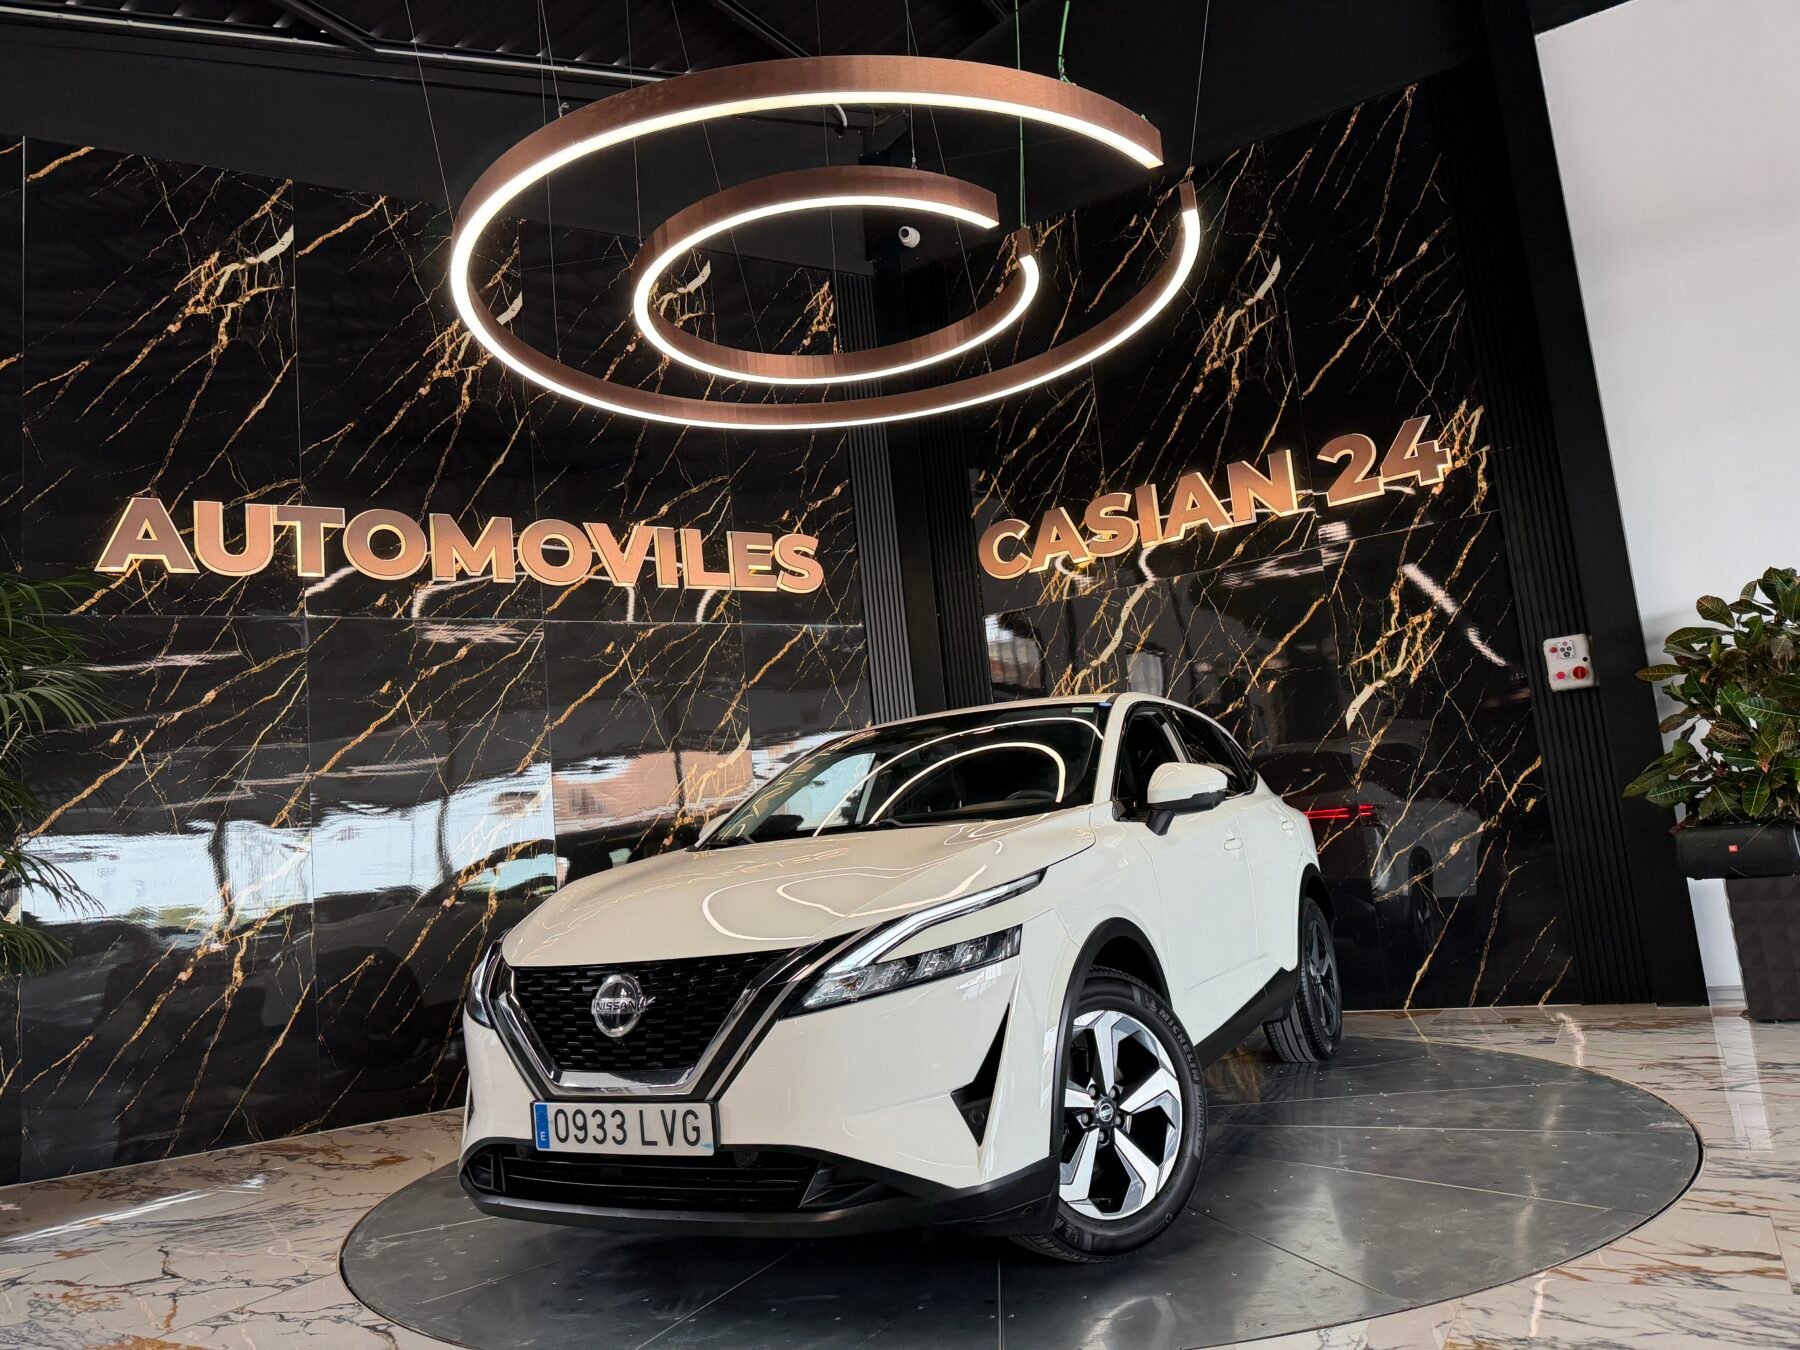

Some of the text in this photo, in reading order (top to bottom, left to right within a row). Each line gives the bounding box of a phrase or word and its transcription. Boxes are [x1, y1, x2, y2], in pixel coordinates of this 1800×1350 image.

[978, 414, 1452, 580] CASIAN 24
[94, 496, 824, 593] AUTOMOVILES
[595, 1000, 637, 1011] NISSAN
[1158, 1008, 1200, 1081] MICHELIN
[540, 1131, 546, 1141] E
[554, 1108, 701, 1147] 0933 LVG
